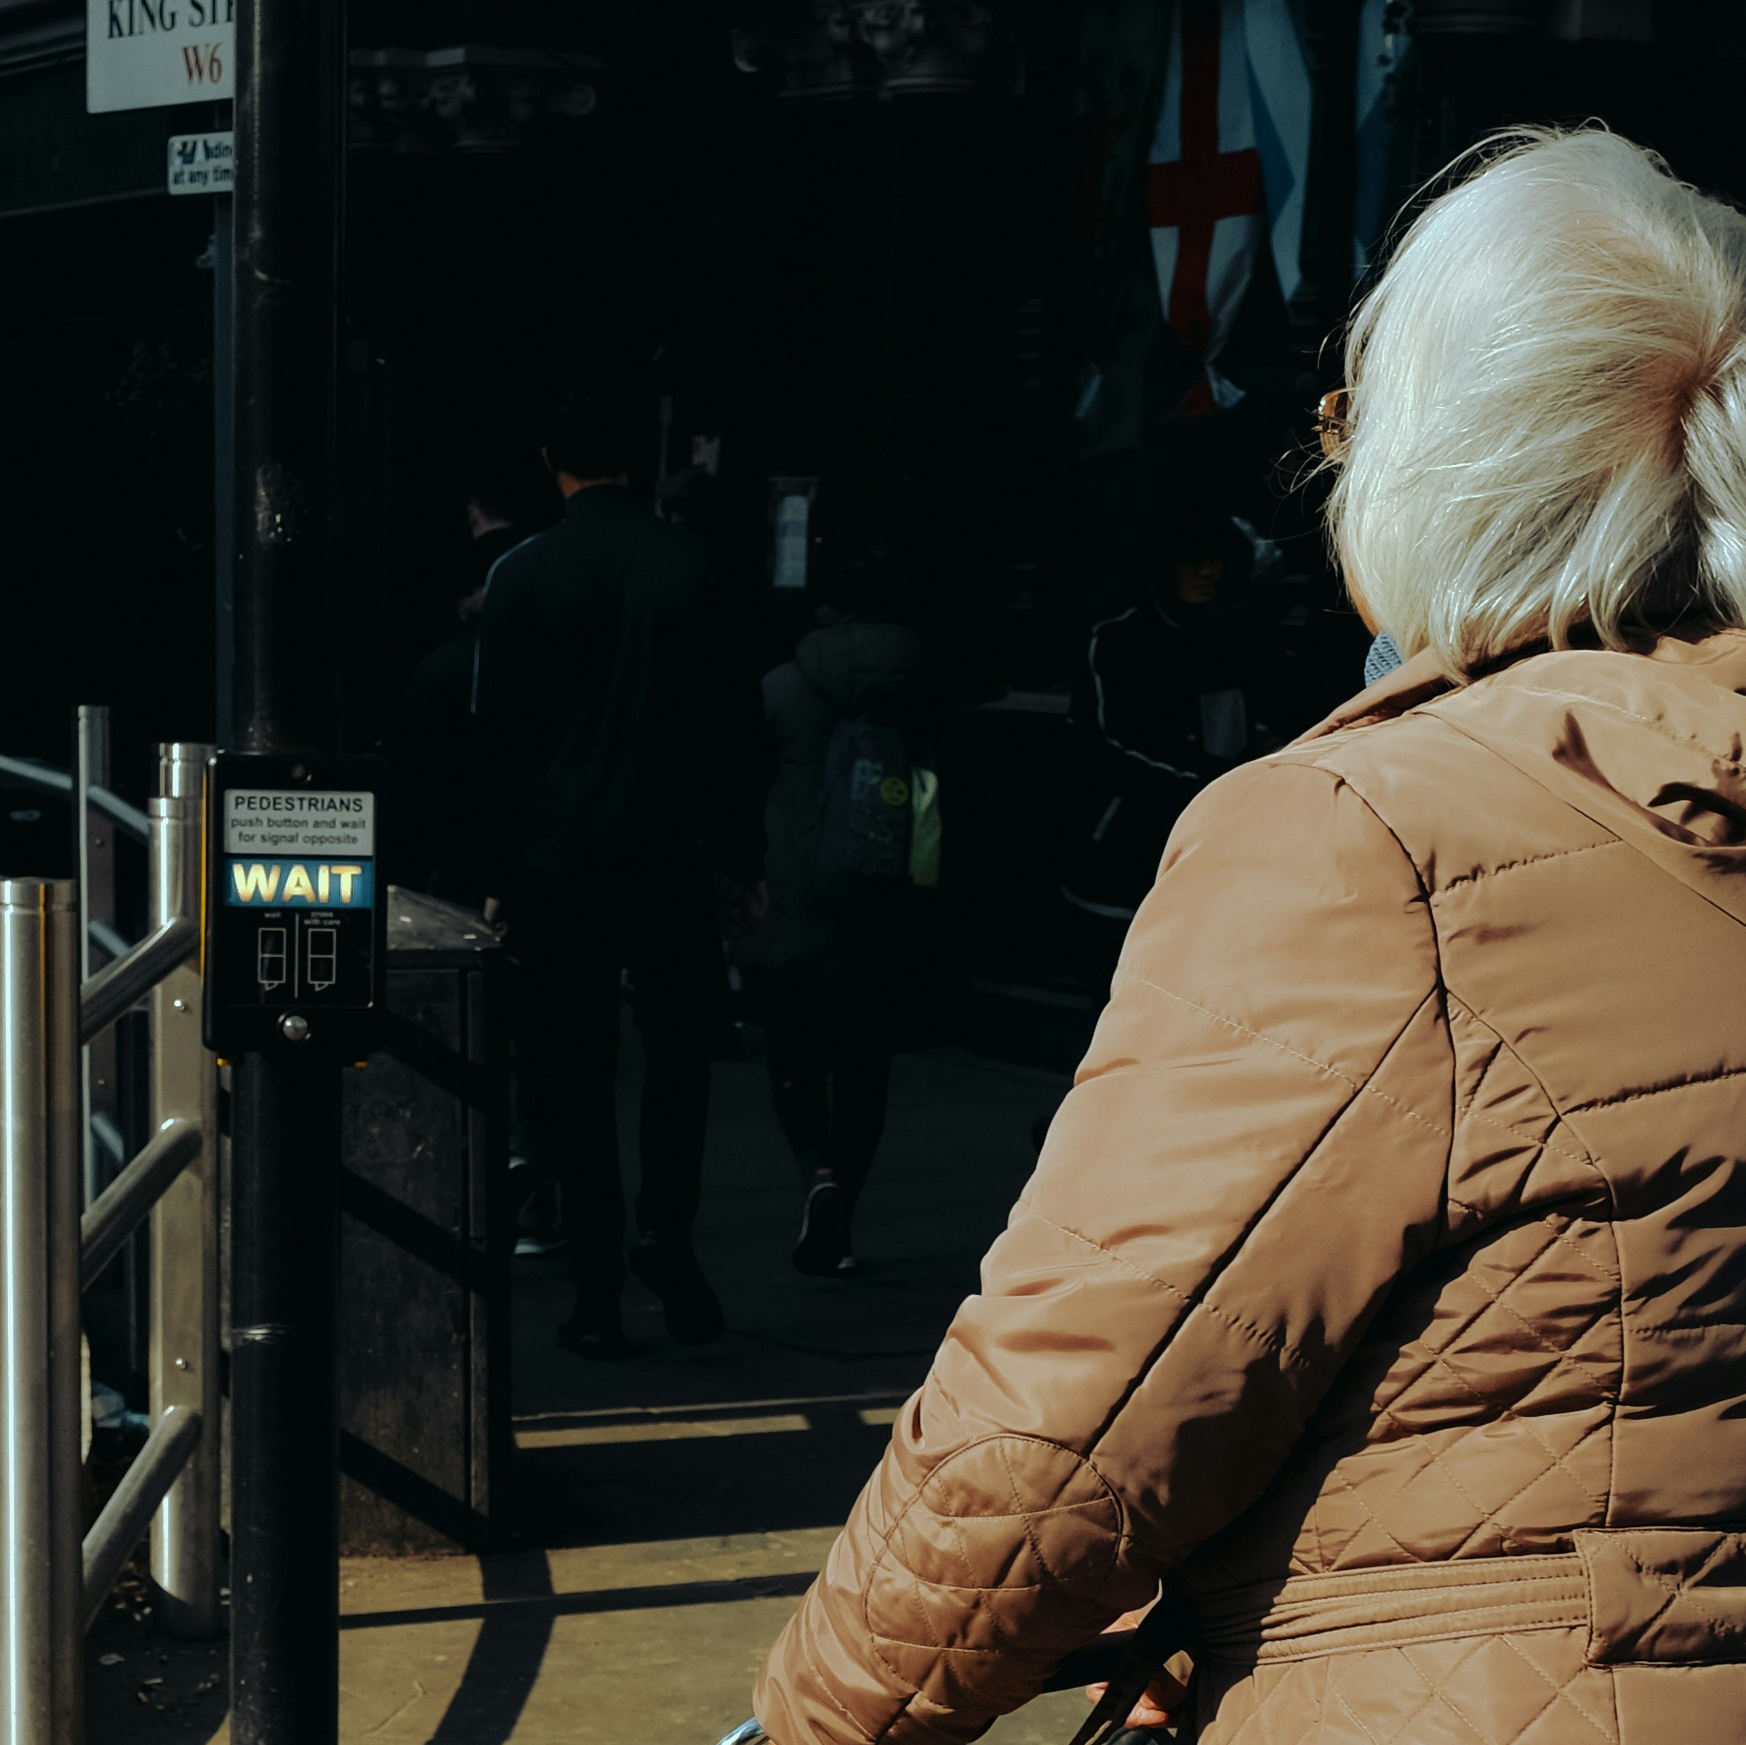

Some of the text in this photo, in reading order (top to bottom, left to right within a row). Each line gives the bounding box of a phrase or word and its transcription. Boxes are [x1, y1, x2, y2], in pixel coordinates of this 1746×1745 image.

[107, 0, 178, 38] KING
[182, 43, 223, 85] W6
[234, 796, 363, 812] PEDESTRIANS
[231, 817, 366, 829] push button and wait
[238, 831, 359, 846] for signal opposite
[232, 863, 363, 904] WAIT
